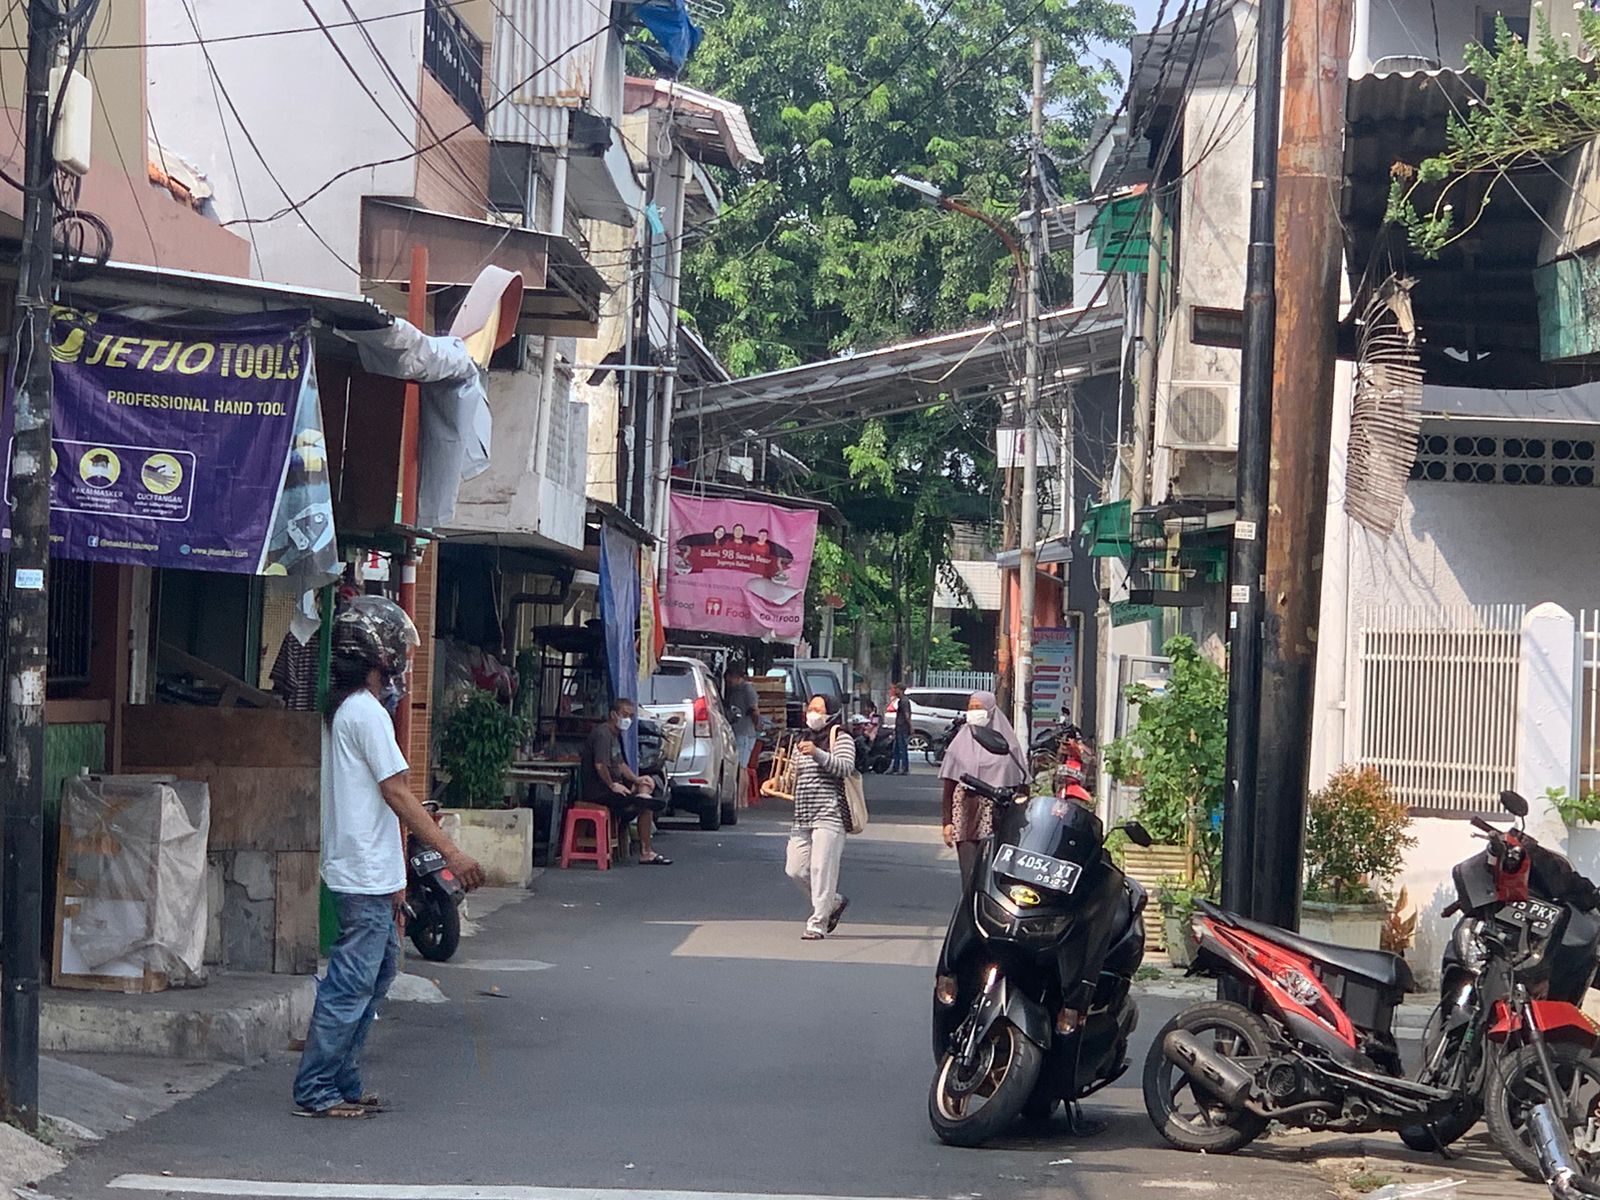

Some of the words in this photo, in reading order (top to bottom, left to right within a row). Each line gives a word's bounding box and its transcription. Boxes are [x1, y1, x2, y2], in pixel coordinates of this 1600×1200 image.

[85, 335, 215, 375] JETJO
[219, 342, 301, 380] TOOLS
[107, 391, 209, 413] PROFESSIONAL
[214, 399, 253, 415] HAND
[256, 402, 287, 416] TOOL
[154, 494, 183, 503] TANGAN
[722, 549, 735, 560] 98
[725, 607, 752, 619] Food
[779, 615, 800, 623] FOOD
[1001, 848, 1014, 862] R
[1017, 854, 1051, 873] 4054
[1055, 864, 1075, 879] XT
[1529, 904, 1556, 921] PKX
